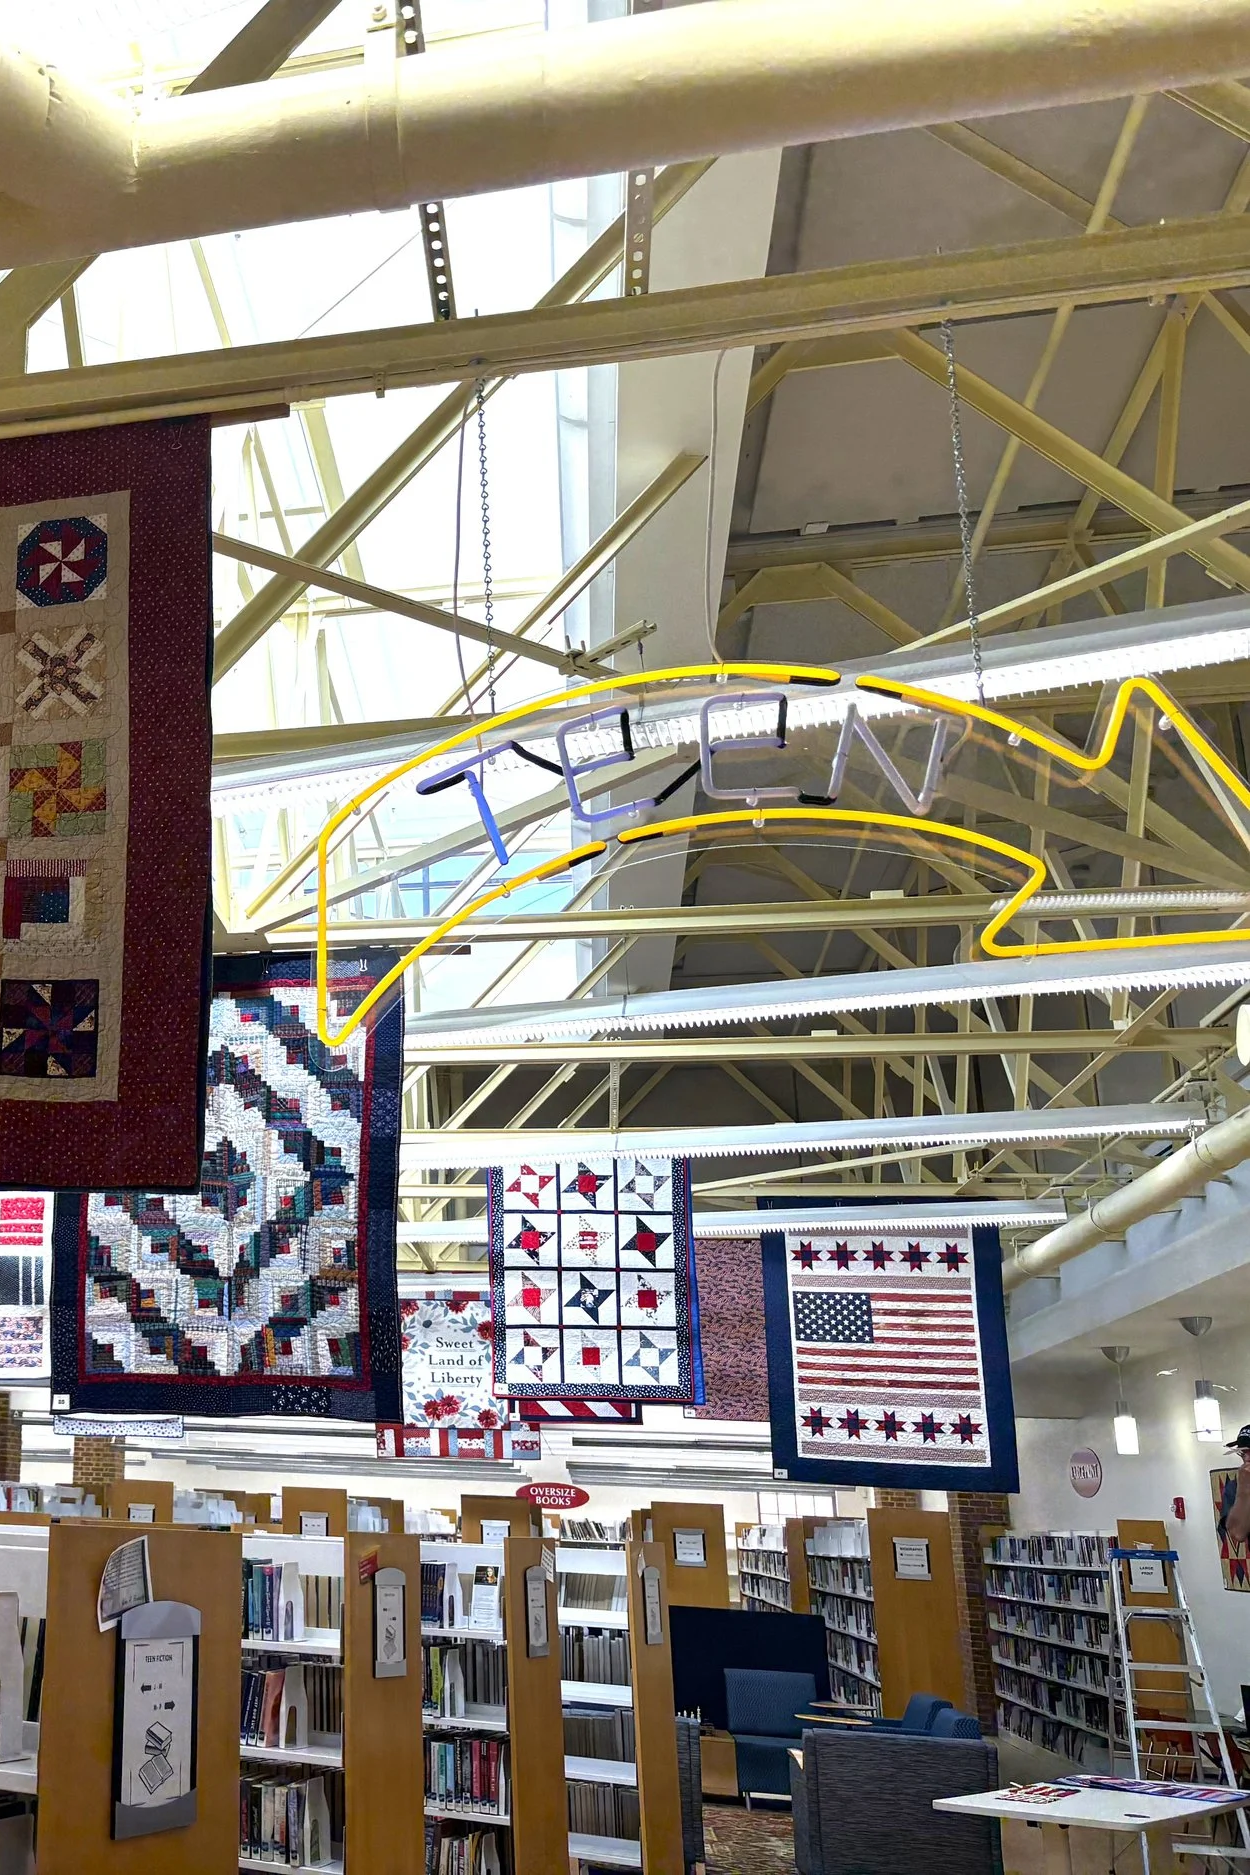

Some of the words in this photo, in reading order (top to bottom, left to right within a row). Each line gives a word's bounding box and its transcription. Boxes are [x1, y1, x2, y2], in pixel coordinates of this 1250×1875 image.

[416, 692, 949, 865] TEEN
[436, 1337, 474, 1349] Sweet
[429, 1354, 464, 1366] Land
[469, 1354, 484, 1366] of
[430, 1371, 483, 1388] Liberty
[530, 1486, 576, 1497] OVERSIZE
[536, 1496, 571, 1506] BOOKS
